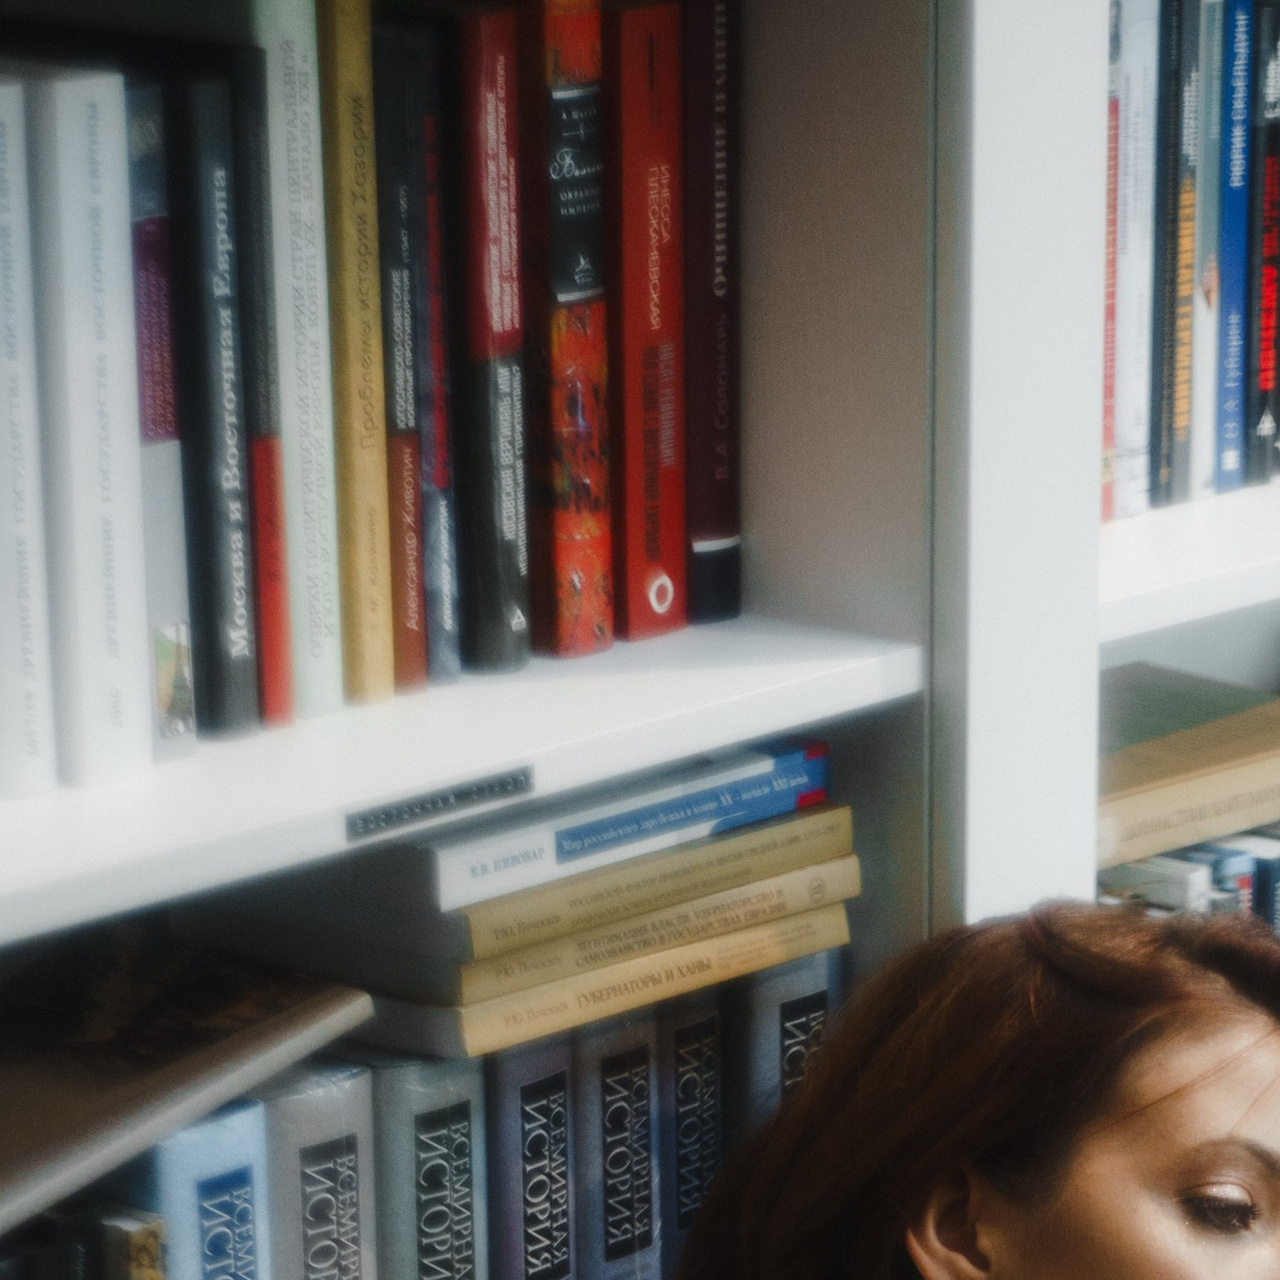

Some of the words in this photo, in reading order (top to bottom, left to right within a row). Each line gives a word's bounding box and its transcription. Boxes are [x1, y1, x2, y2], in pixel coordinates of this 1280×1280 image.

[351, 94, 369, 205] Хазарии
[660, 164, 671, 244] ИНЕССА
[212, 167, 233, 300] Европа
[355, 213, 375, 311] истории
[647, 166, 662, 330] ПЛЕСКАЧЕВСКАЯ
[218, 306, 242, 492] Восточная
[357, 320, 380, 450] Проблемы
[498, 395, 515, 465] ВЕРТИКАЛЬ
[229, 500, 243, 523] и
[402, 446, 417, 529] Животич
[500, 468, 517, 541] КОСОВСКАЯ
[229, 531, 250, 660] Москва
[405, 531, 420, 631] Александр
[575, 971, 664, 1008] ГУБЕРНАТОРЫ
[675, 957, 714, 979] ХАНЫ
[604, 1072, 633, 1246] ИСТОРИЯ
[632, 1065, 651, 1238] ВСЕМИРНАЯ
[677, 1043, 702, 1215] ИСТОРИЯ
[702, 1036, 718, 1192] ВСЕМИРНА
[522, 1099, 552, 1277] ИСТОРИЯ
[548, 1091, 569, 1267] ВСЕМИРНАЯ
